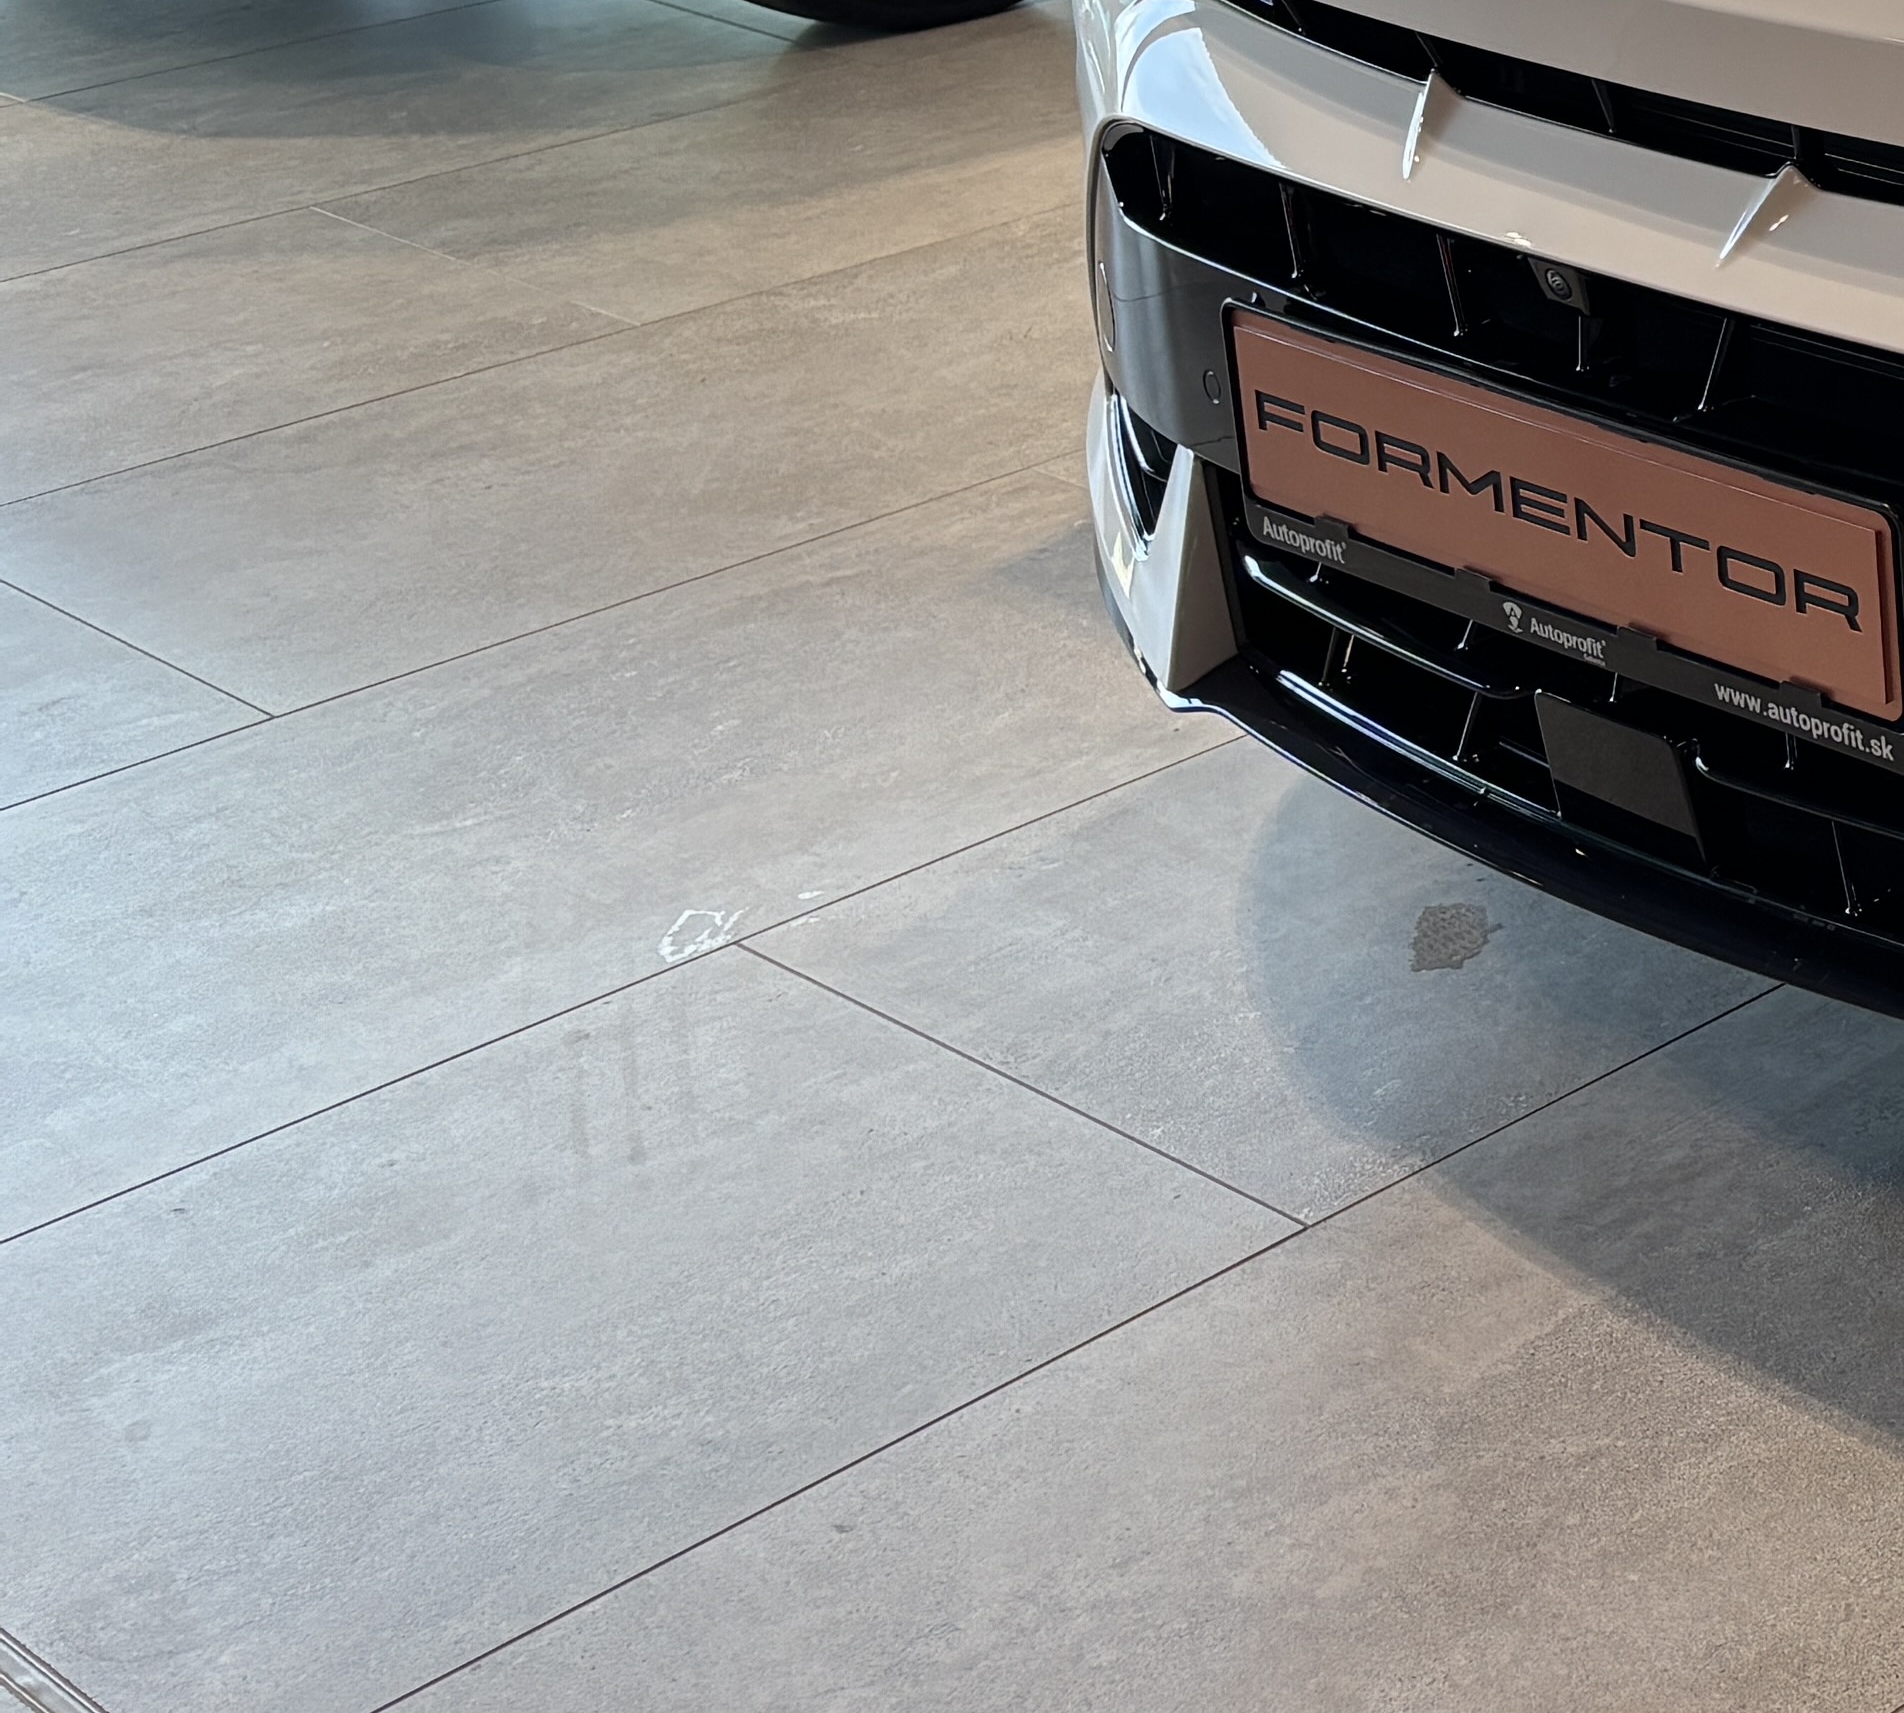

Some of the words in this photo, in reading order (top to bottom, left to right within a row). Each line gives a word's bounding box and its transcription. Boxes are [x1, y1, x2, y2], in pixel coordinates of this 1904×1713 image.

[1254, 389, 1863, 633] FORMENTOR
[1263, 516, 1346, 564] Autoprofit
[1530, 617, 1606, 658] Autoprofit
[1714, 683, 1894, 761] www.autoprofit.sk
